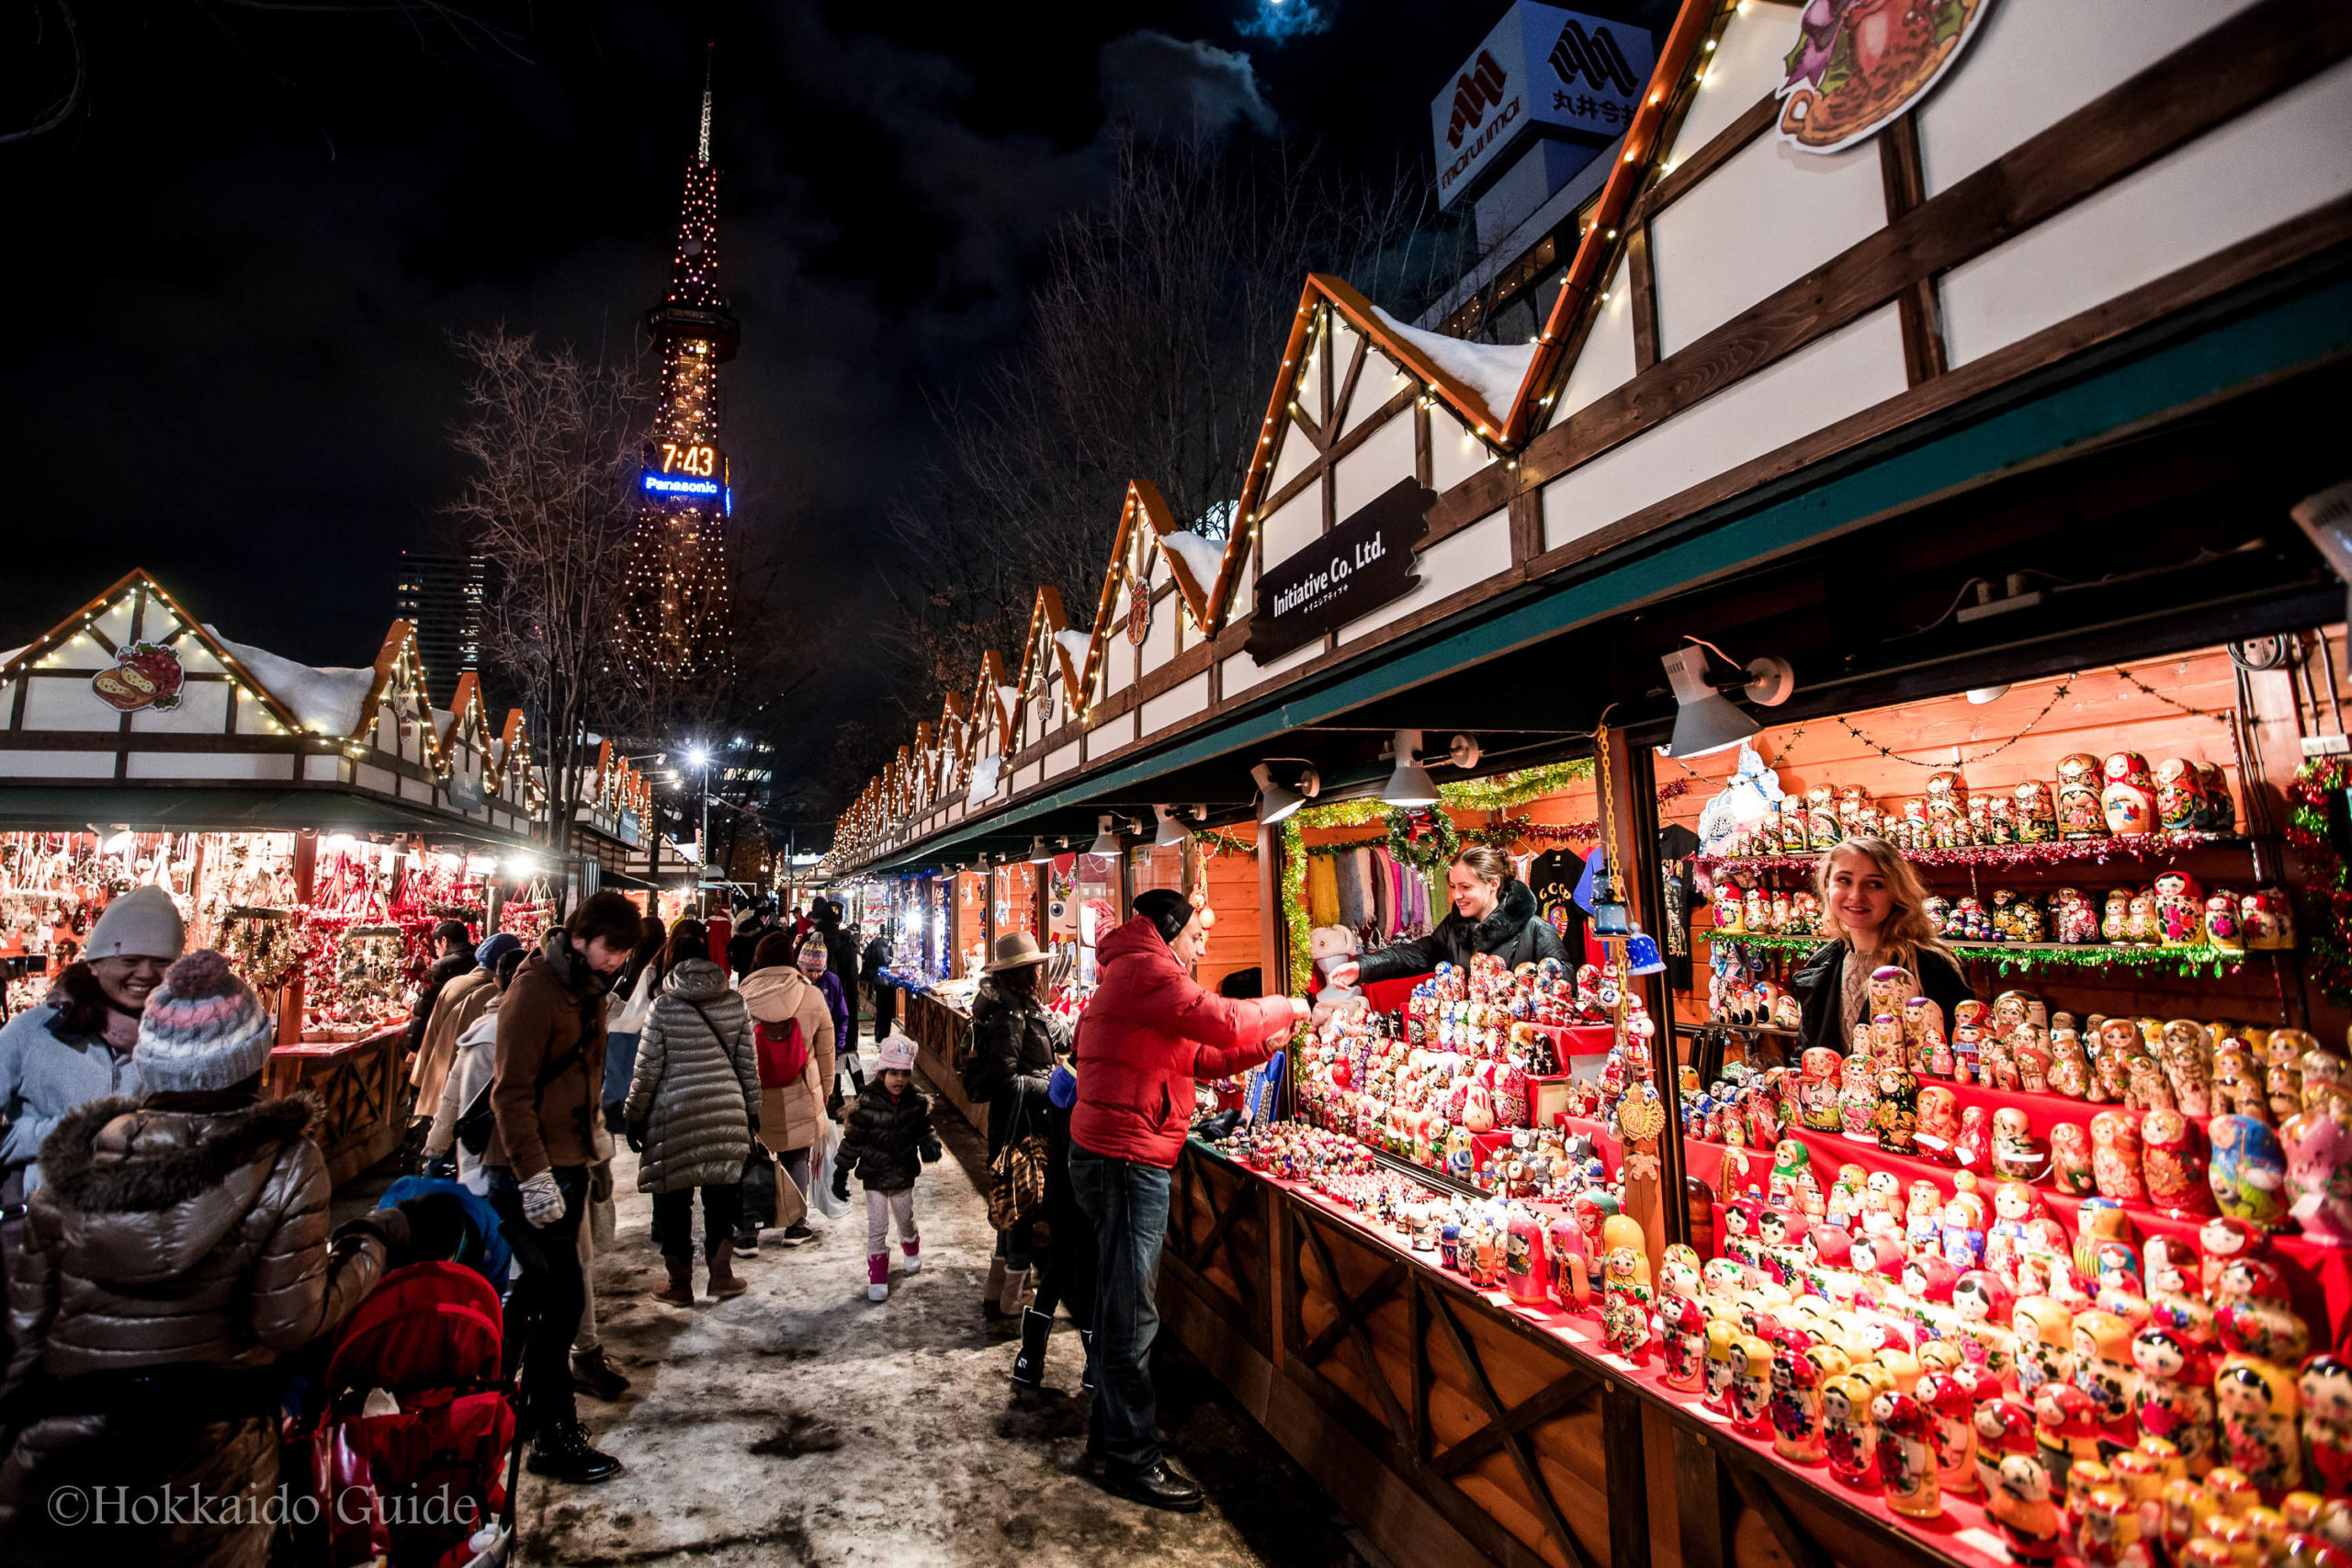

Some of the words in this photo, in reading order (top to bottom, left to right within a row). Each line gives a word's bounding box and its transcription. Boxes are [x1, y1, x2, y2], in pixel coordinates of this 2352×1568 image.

[662, 444, 714, 477] 7:43
[646, 477, 718, 493] Panasonic
[1273, 571, 1329, 617] Initiative
[1331, 557, 1352, 582] Co.
[1355, 531, 1386, 570] Ltd.
